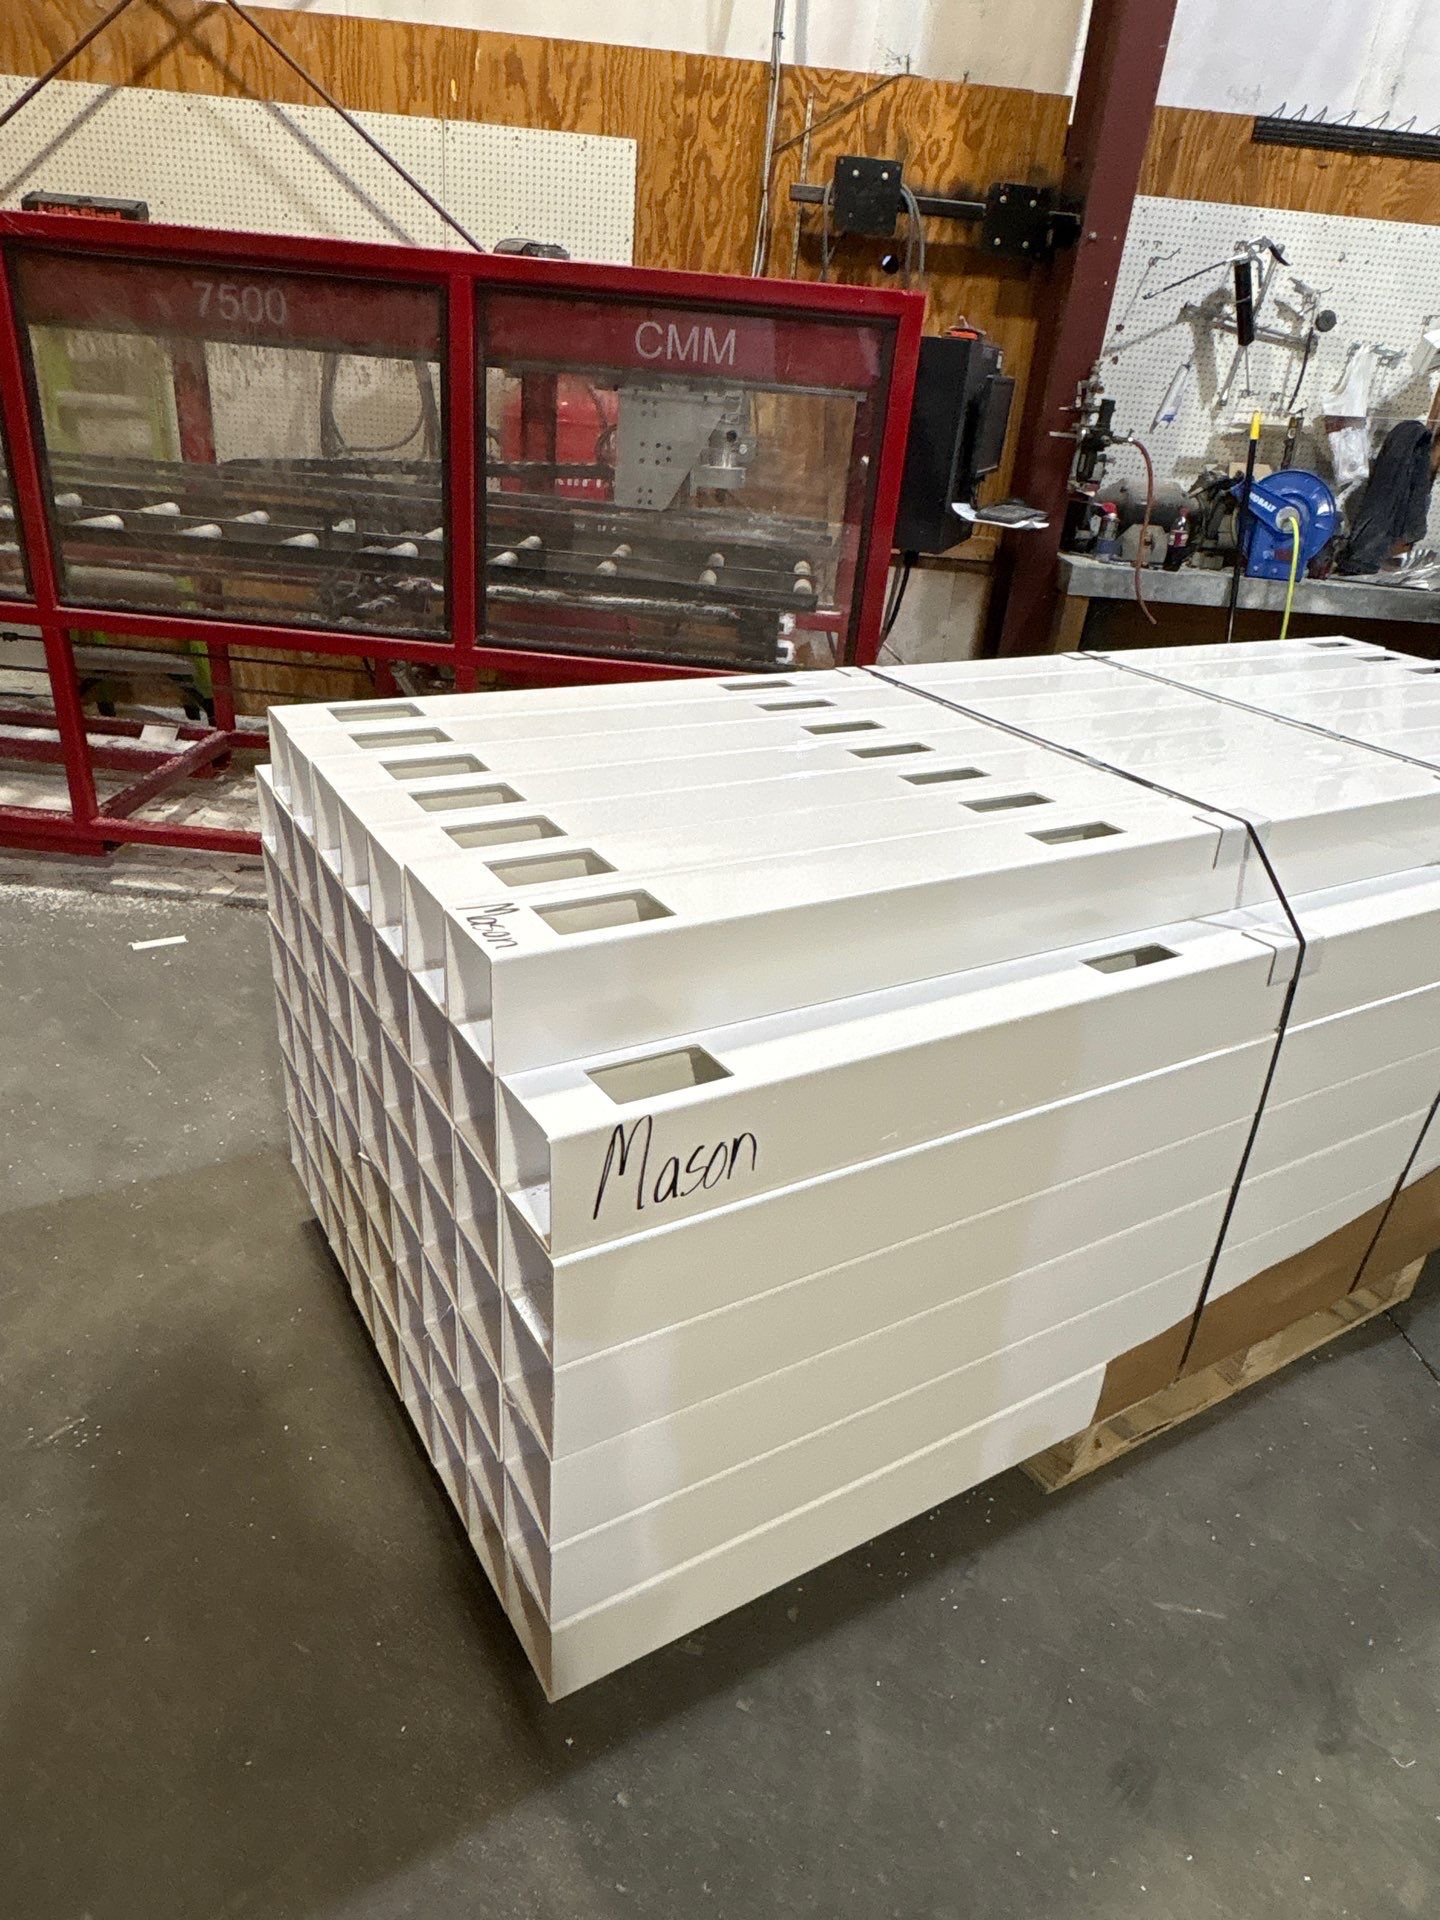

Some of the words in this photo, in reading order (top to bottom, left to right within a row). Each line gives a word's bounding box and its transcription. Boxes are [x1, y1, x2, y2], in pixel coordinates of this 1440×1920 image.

[192, 281, 287, 324] 7500
[635, 321, 736, 366] CMM
[456, 903, 520, 949] Mason
[593, 1114, 757, 1220] Mason
